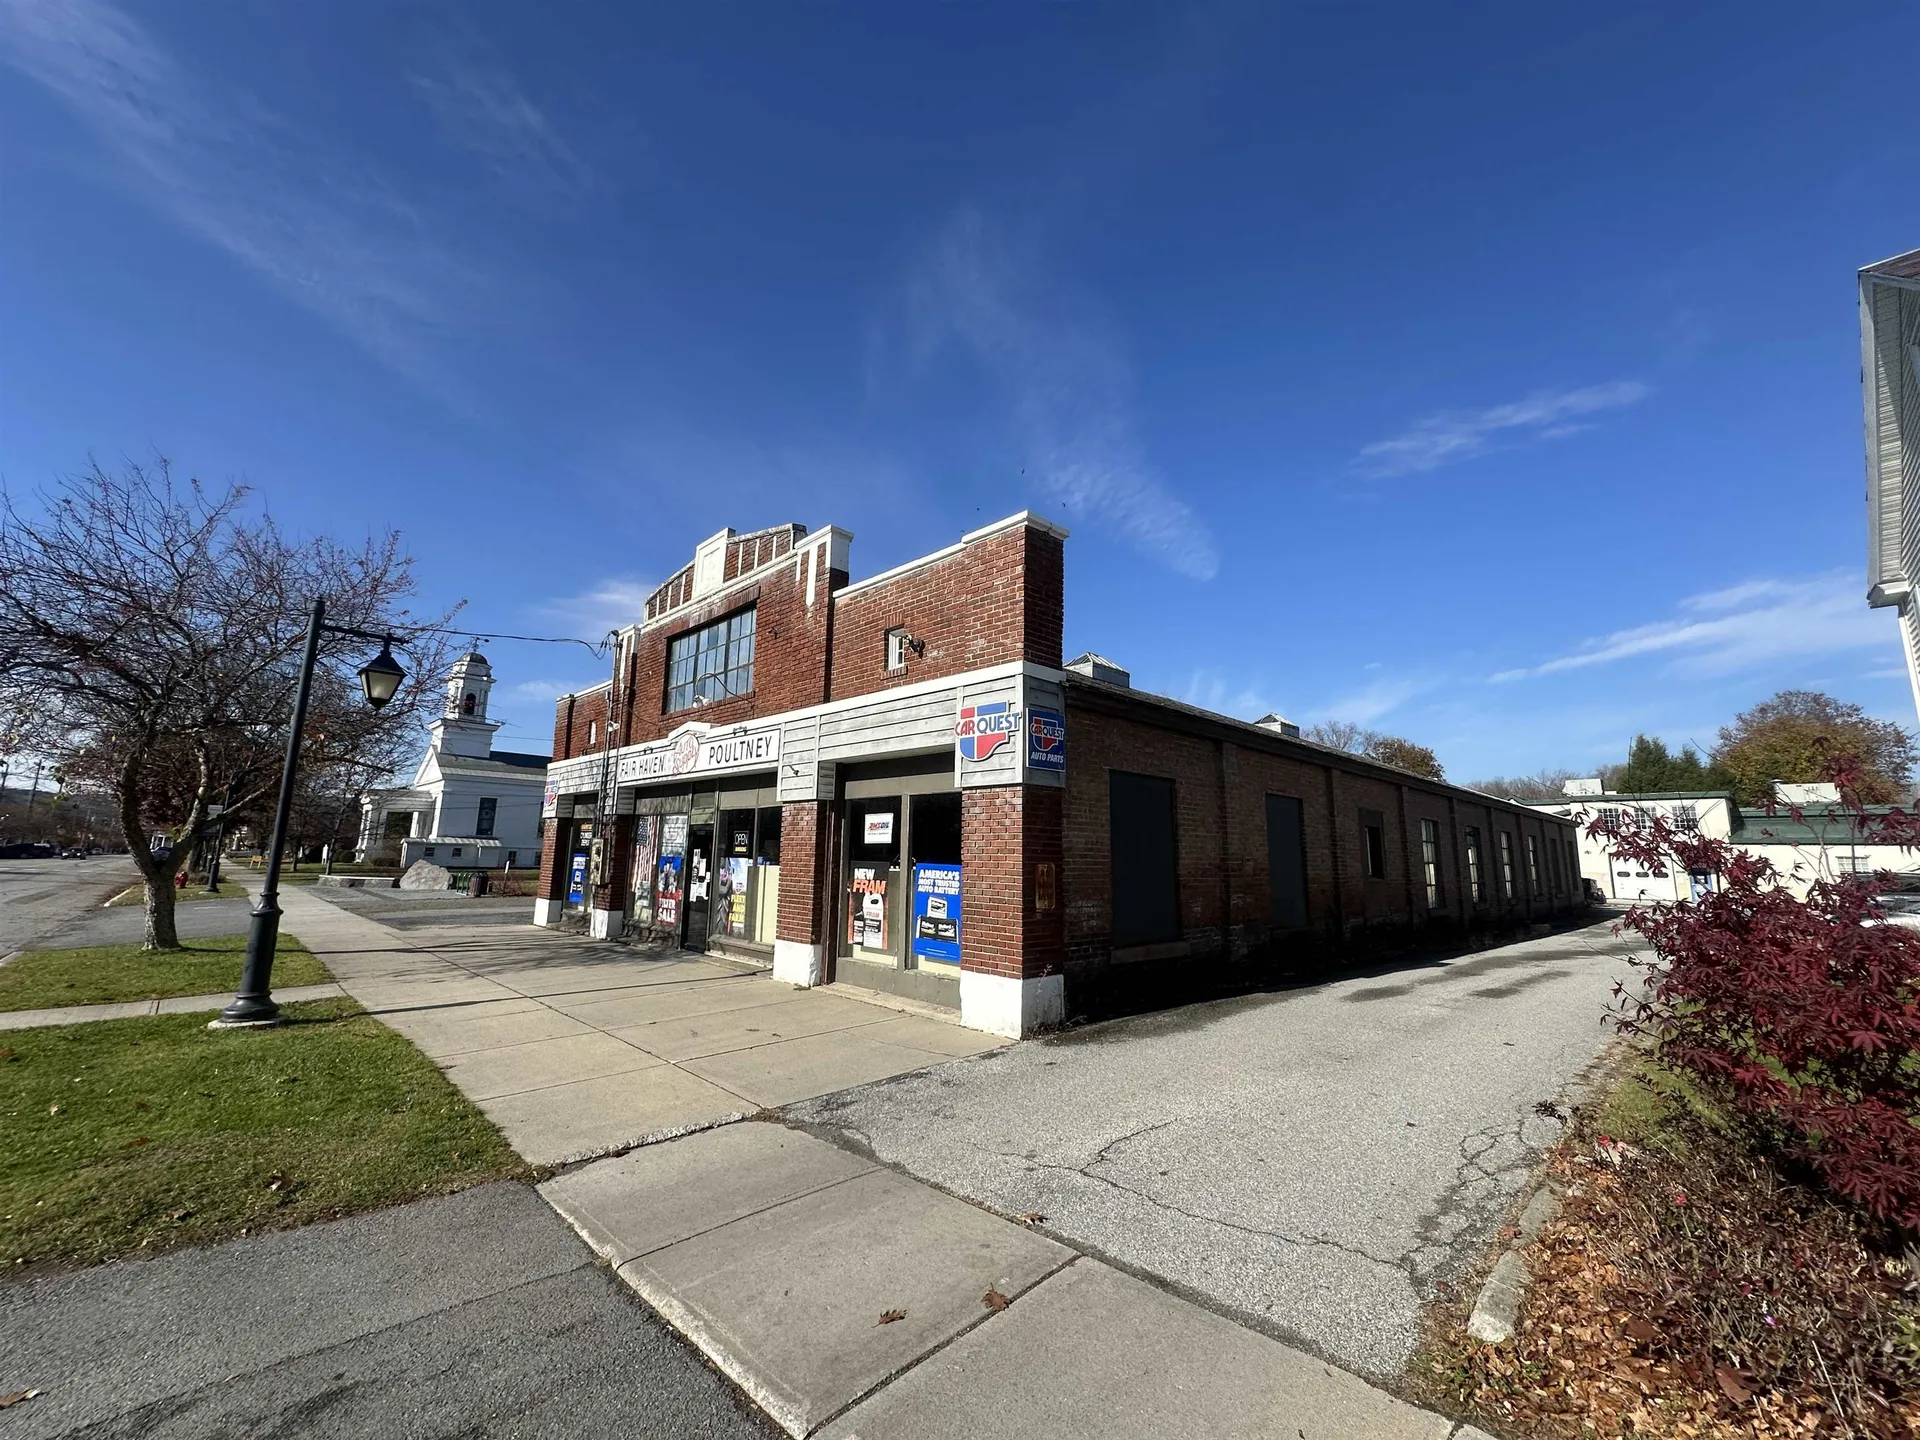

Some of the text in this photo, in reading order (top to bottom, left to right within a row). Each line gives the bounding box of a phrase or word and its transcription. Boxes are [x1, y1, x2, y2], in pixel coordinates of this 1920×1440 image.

[954, 712, 1019, 736] CARQUEST
[1030, 723, 1064, 740] CARQUEST
[709, 736, 772, 765] POULTNEY
[1031, 751, 1064, 763] AUTO PARTS
[620, 755, 665, 778] FAIR HAVEN
[735, 833, 748, 845] OPEN
[854, 868, 875, 880] NEW
[919, 869, 960, 881] AMERICA'S
[853, 880, 887, 895] FRAM
[918, 879, 960, 888] MOST TRUSTED
[918, 885, 960, 895] AUTO BATTERY
[657, 908, 675, 922] SALE
